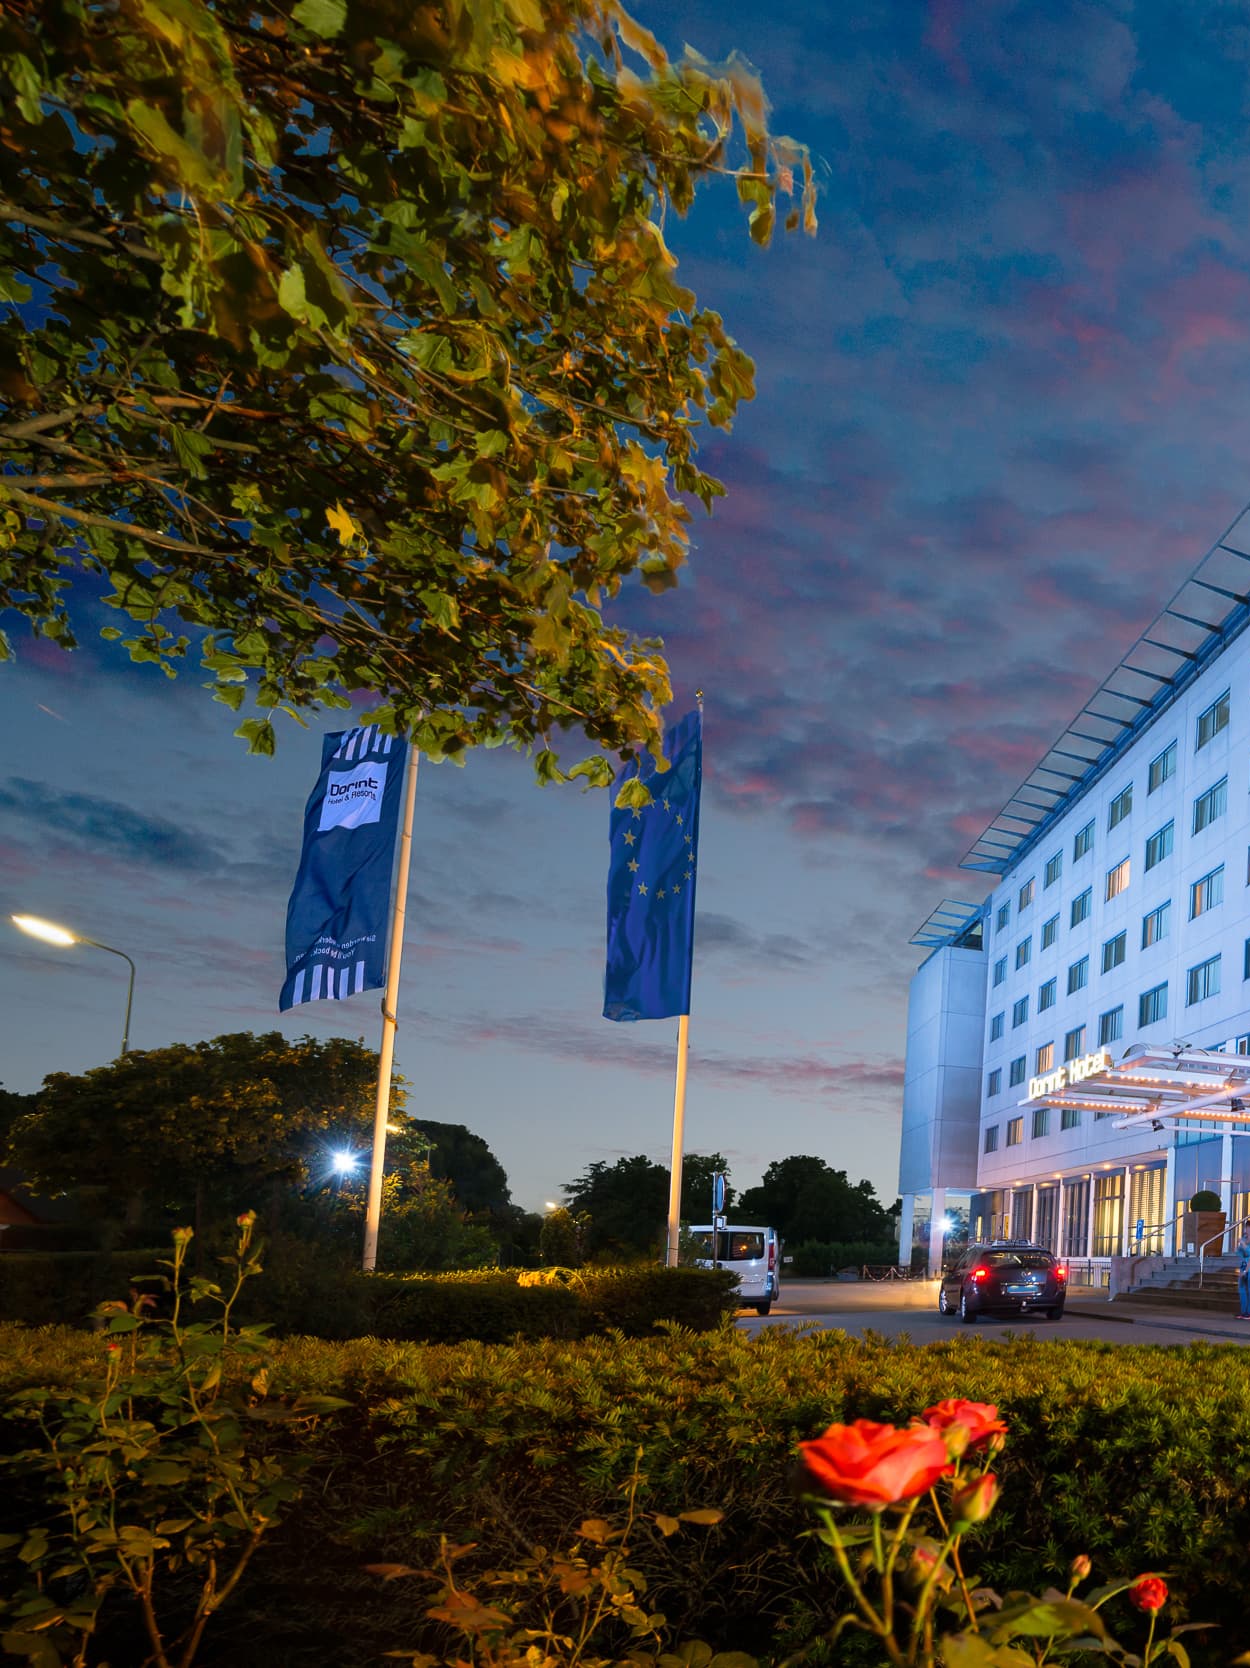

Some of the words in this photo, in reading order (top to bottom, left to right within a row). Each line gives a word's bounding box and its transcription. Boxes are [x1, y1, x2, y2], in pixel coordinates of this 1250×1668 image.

[330, 777, 378, 796] Dorint
[1029, 1066, 1066, 1099] Dorint
[1069, 1046, 1105, 1085] Hotel
